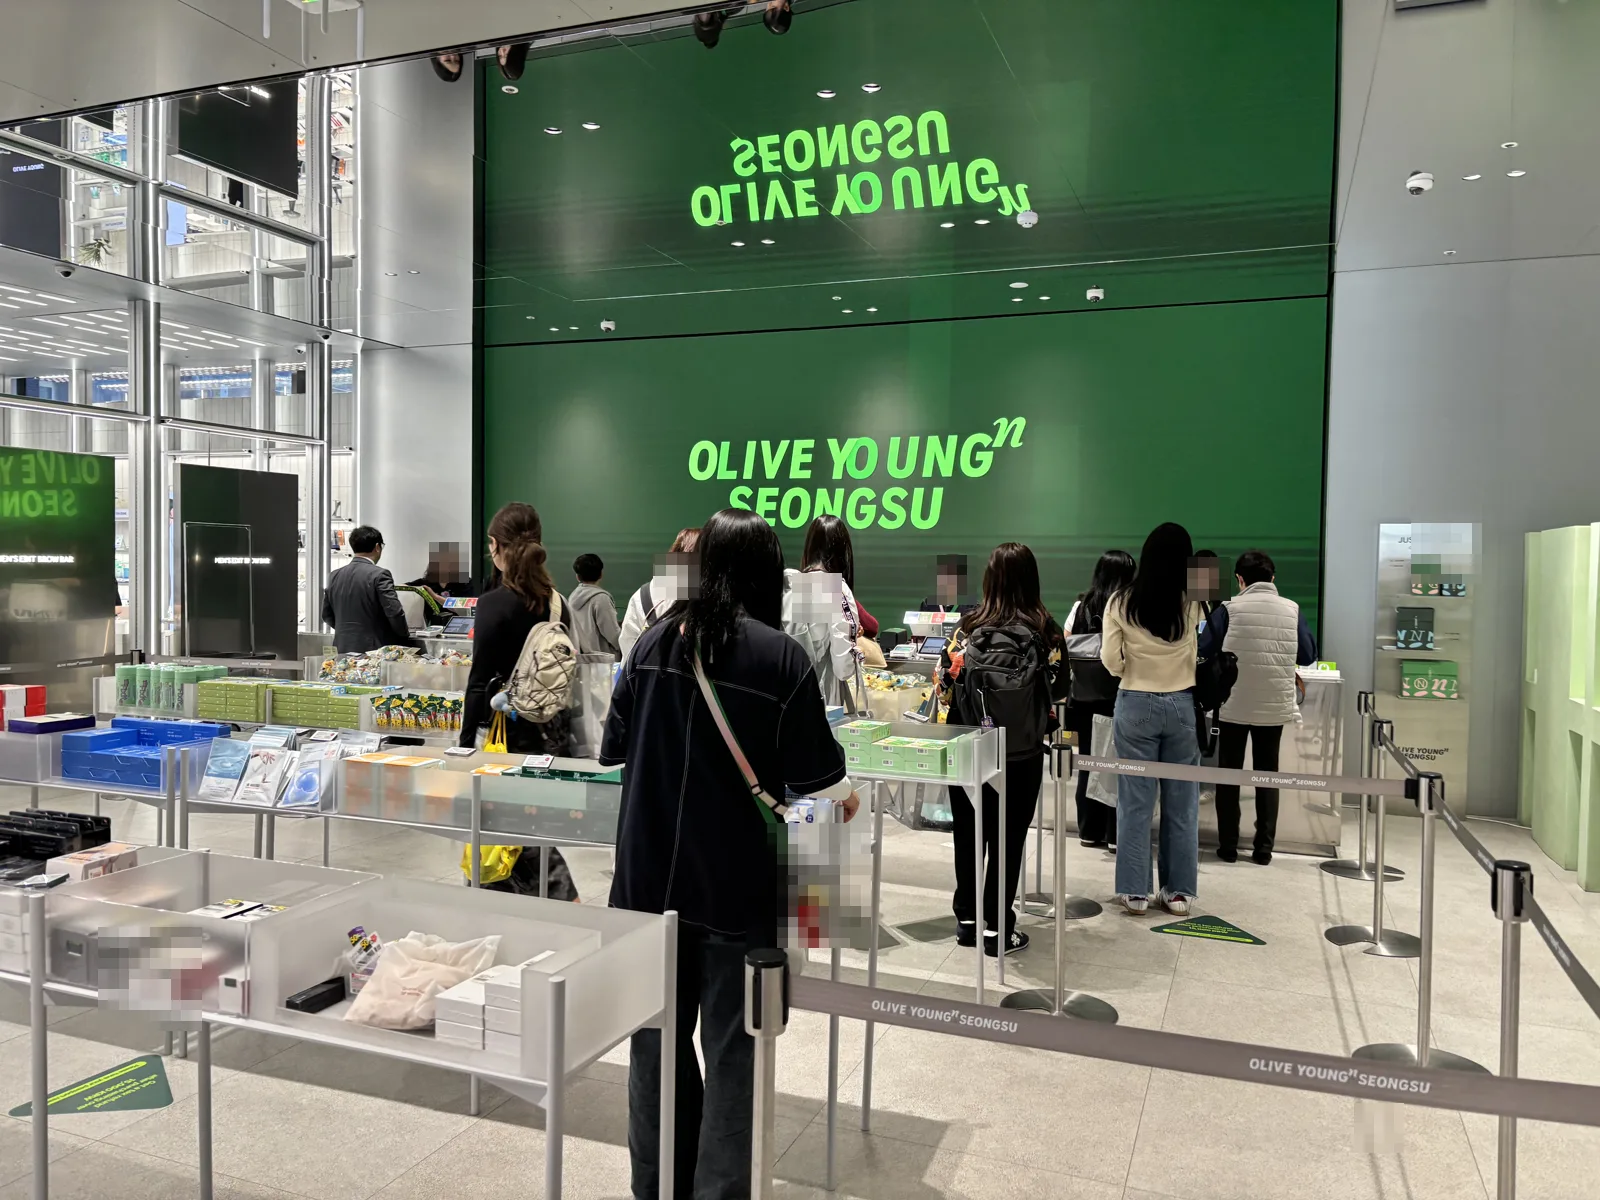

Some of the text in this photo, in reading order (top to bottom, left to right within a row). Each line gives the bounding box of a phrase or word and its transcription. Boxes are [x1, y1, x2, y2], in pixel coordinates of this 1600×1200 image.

[688, 439, 815, 481] OLIVE
[729, 485, 943, 530] SEONGSU
[871, 1000, 907, 1015] OLIVE
[959, 1014, 1018, 1033] SEONGSU
[1249, 1058, 1293, 1074] OLIVE
[1358, 1073, 1431, 1094] SEONGSU
